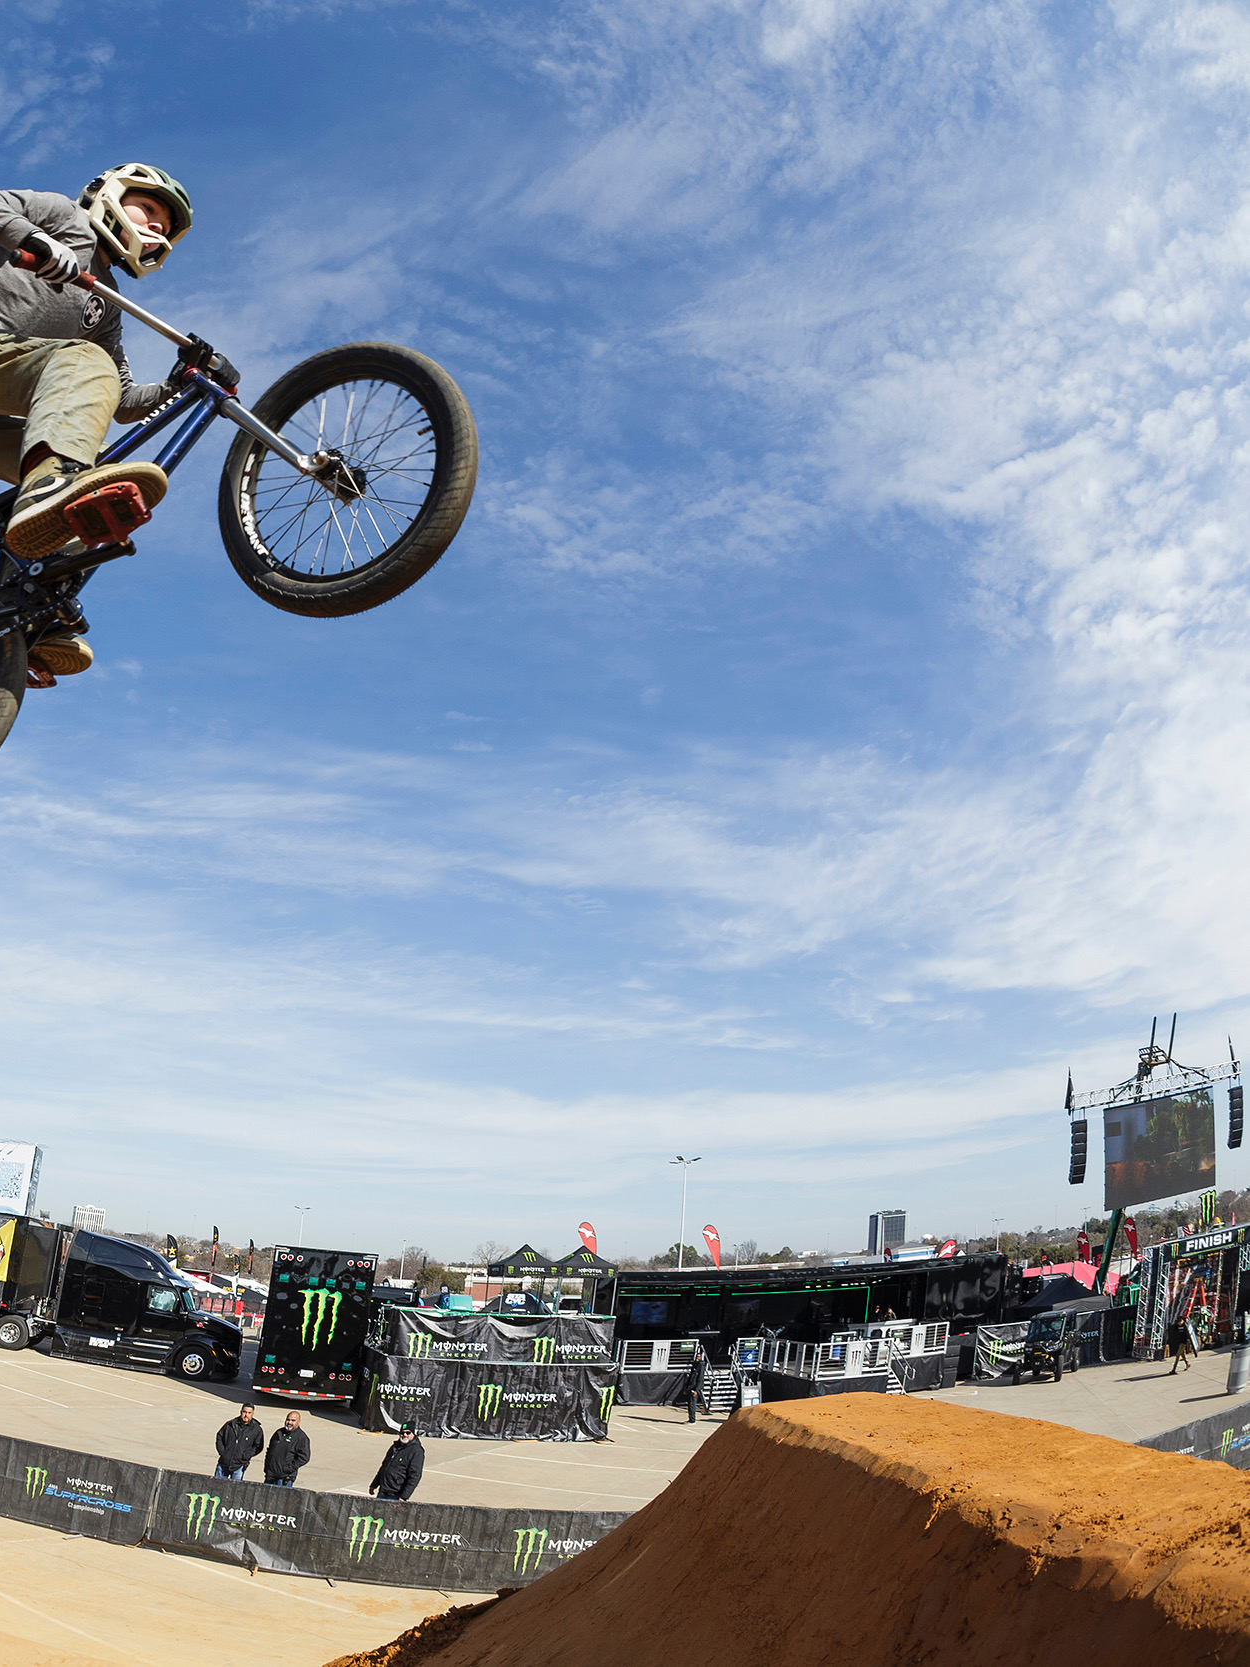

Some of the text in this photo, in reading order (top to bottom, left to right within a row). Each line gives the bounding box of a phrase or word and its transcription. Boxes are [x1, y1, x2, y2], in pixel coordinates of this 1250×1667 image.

[140, 392, 182, 425] HUFFY
[1185, 1231, 1232, 1252] FINISH
[432, 1341, 488, 1352] MONSTER
[555, 1343, 607, 1354] MONSTER
[377, 1383, 431, 1397] MONSTER
[503, 1391, 557, 1403] MONSTER
[381, 1394, 422, 1402] ENERGY
[66, 1477, 114, 1493] MONSTER
[72, 1486, 106, 1496] ENERGY
[44, 1487, 132, 1513] SUPERCROSS
[67, 1501, 104, 1515] Championship
[220, 1507, 296, 1528] MONSTER
[230, 1522, 283, 1533] ENERGY
[384, 1528, 461, 1545] MONSTER
[394, 1543, 448, 1552] ENERGY
[548, 1538, 597, 1552] MONS
